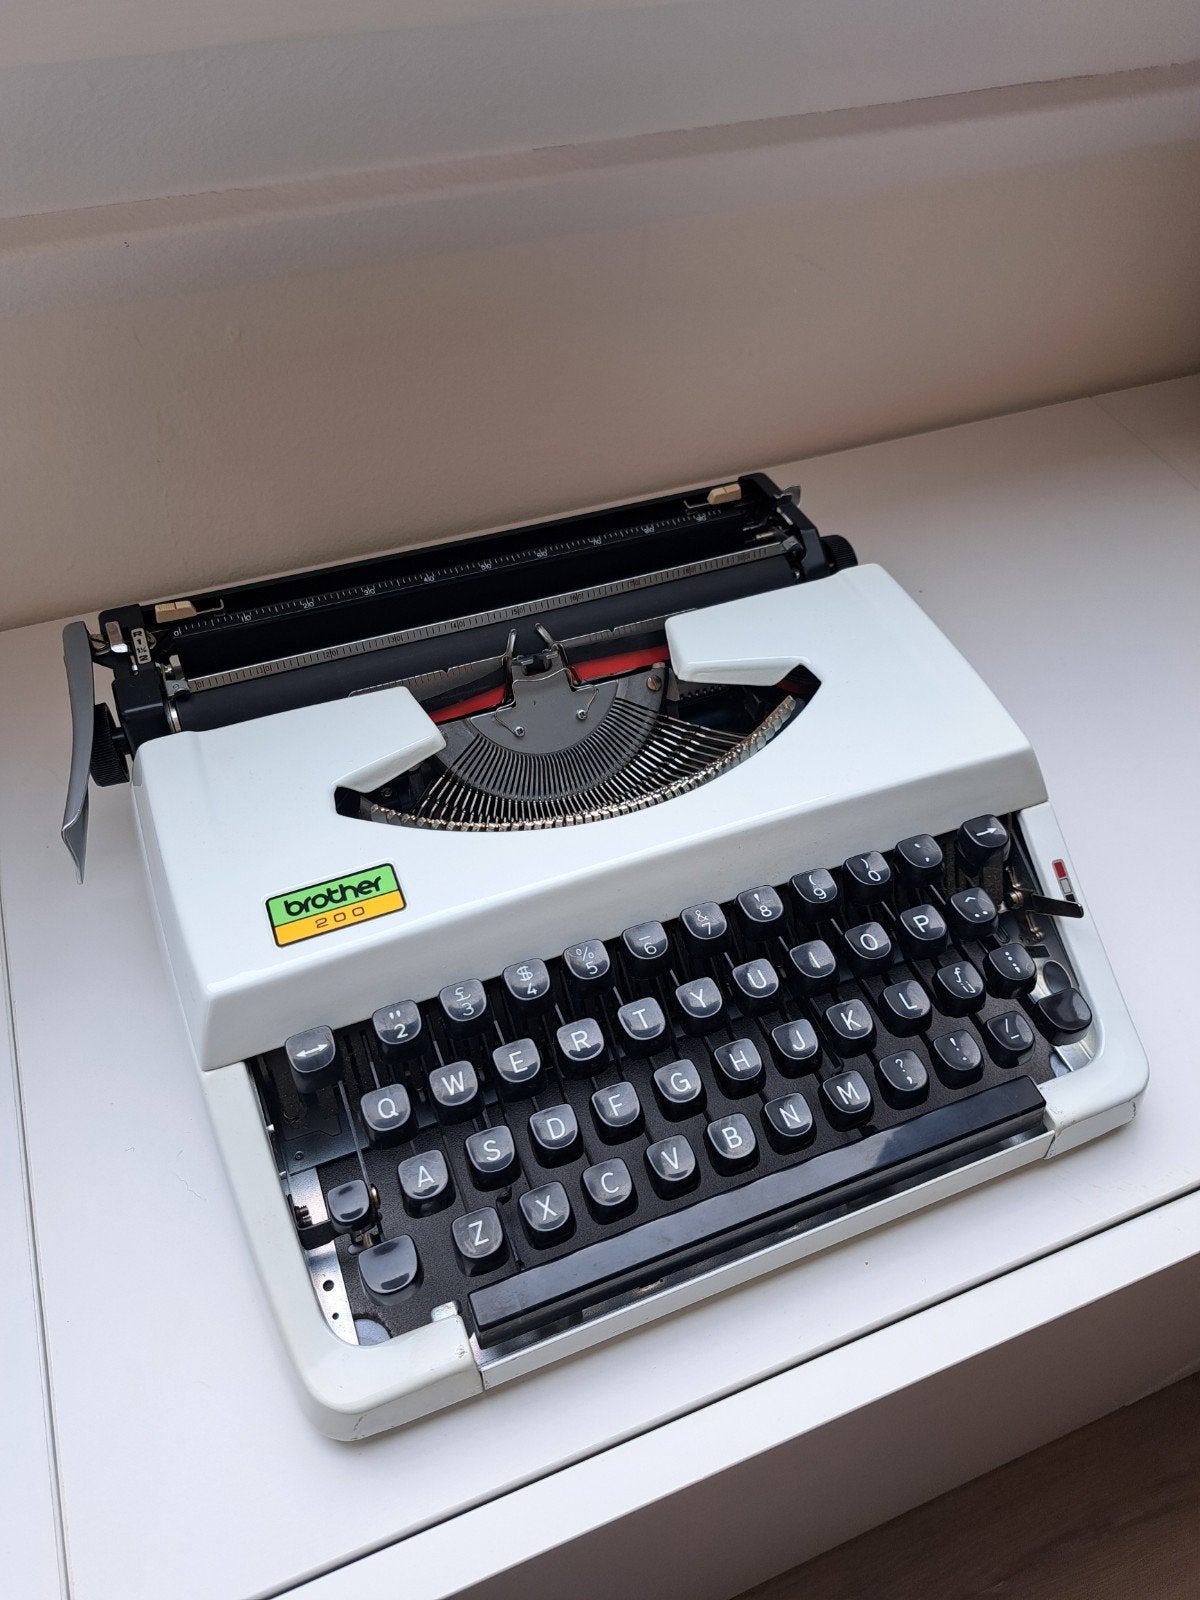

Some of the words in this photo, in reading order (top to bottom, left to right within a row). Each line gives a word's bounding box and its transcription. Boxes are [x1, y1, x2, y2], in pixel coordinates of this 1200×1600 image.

[284, 875, 382, 917] brother
[813, 888, 827, 900] 9
[315, 906, 365, 928] 200
[695, 909, 709, 922] &
[759, 905, 772, 917] 8
[702, 922, 712, 935] 7
[913, 914, 929, 933] P
[643, 942, 657, 955] 6
[860, 933, 878, 950] O
[575, 946, 594, 961] %
[808, 951, 821, 969] I
[516, 965, 533, 981] $
[585, 961, 598, 975] 5
[527, 982, 538, 995] 4
[747, 970, 767, 989] U
[690, 988, 707, 1008] Y
[899, 992, 918, 1010] L
[461, 1002, 475, 1016] 3
[632, 1008, 649, 1029] T
[841, 1009, 862, 1030] K
[394, 1023, 409, 1039] 2
[570, 1030, 592, 1052] R
[792, 1029, 806, 1051] J
[508, 1050, 528, 1074] E
[729, 1050, 751, 1072] H
[441, 1071, 463, 1096] W
[670, 1072, 692, 1092] G
[836, 1081, 861, 1105] M
[377, 1097, 399, 1119] Q
[608, 1093, 623, 1116] F
[779, 1104, 801, 1127] N
[546, 1117, 565, 1140] D
[721, 1126, 743, 1149] B
[483, 1139, 501, 1161] S
[661, 1147, 680, 1170] V
[417, 1165, 435, 1188] A
[600, 1172, 620, 1194] C
[535, 1195, 558, 1221] X
[468, 1220, 490, 1247] Z
